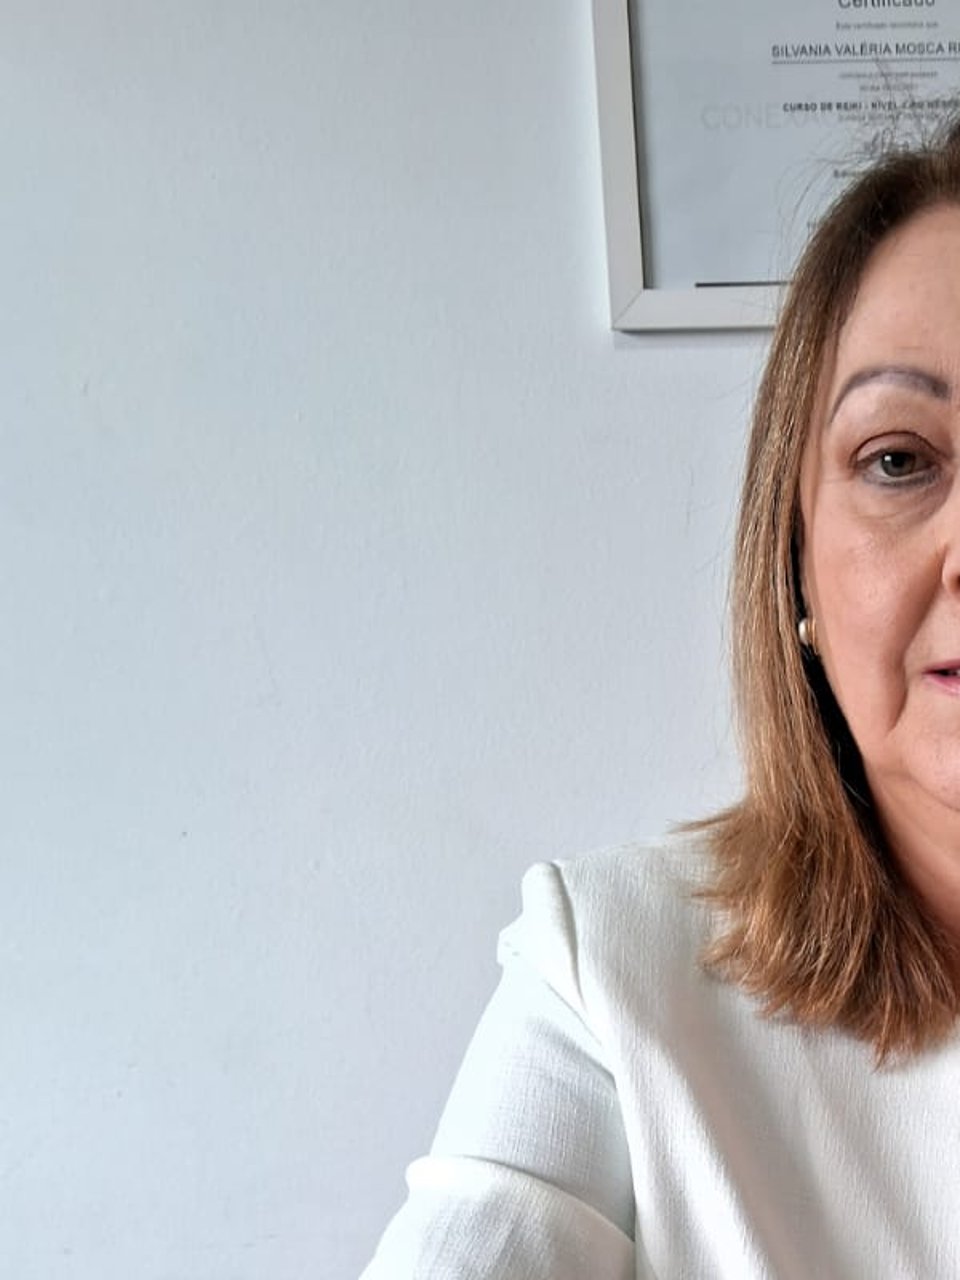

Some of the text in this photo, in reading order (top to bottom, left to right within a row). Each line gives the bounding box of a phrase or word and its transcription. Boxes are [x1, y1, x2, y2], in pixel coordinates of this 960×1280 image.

[771, 43, 832, 58] SILVANIA
[834, 41, 892, 57] VALÉRIA
[895, 42, 944, 56] MOSCA
[782, 101, 818, 113] CURSO
